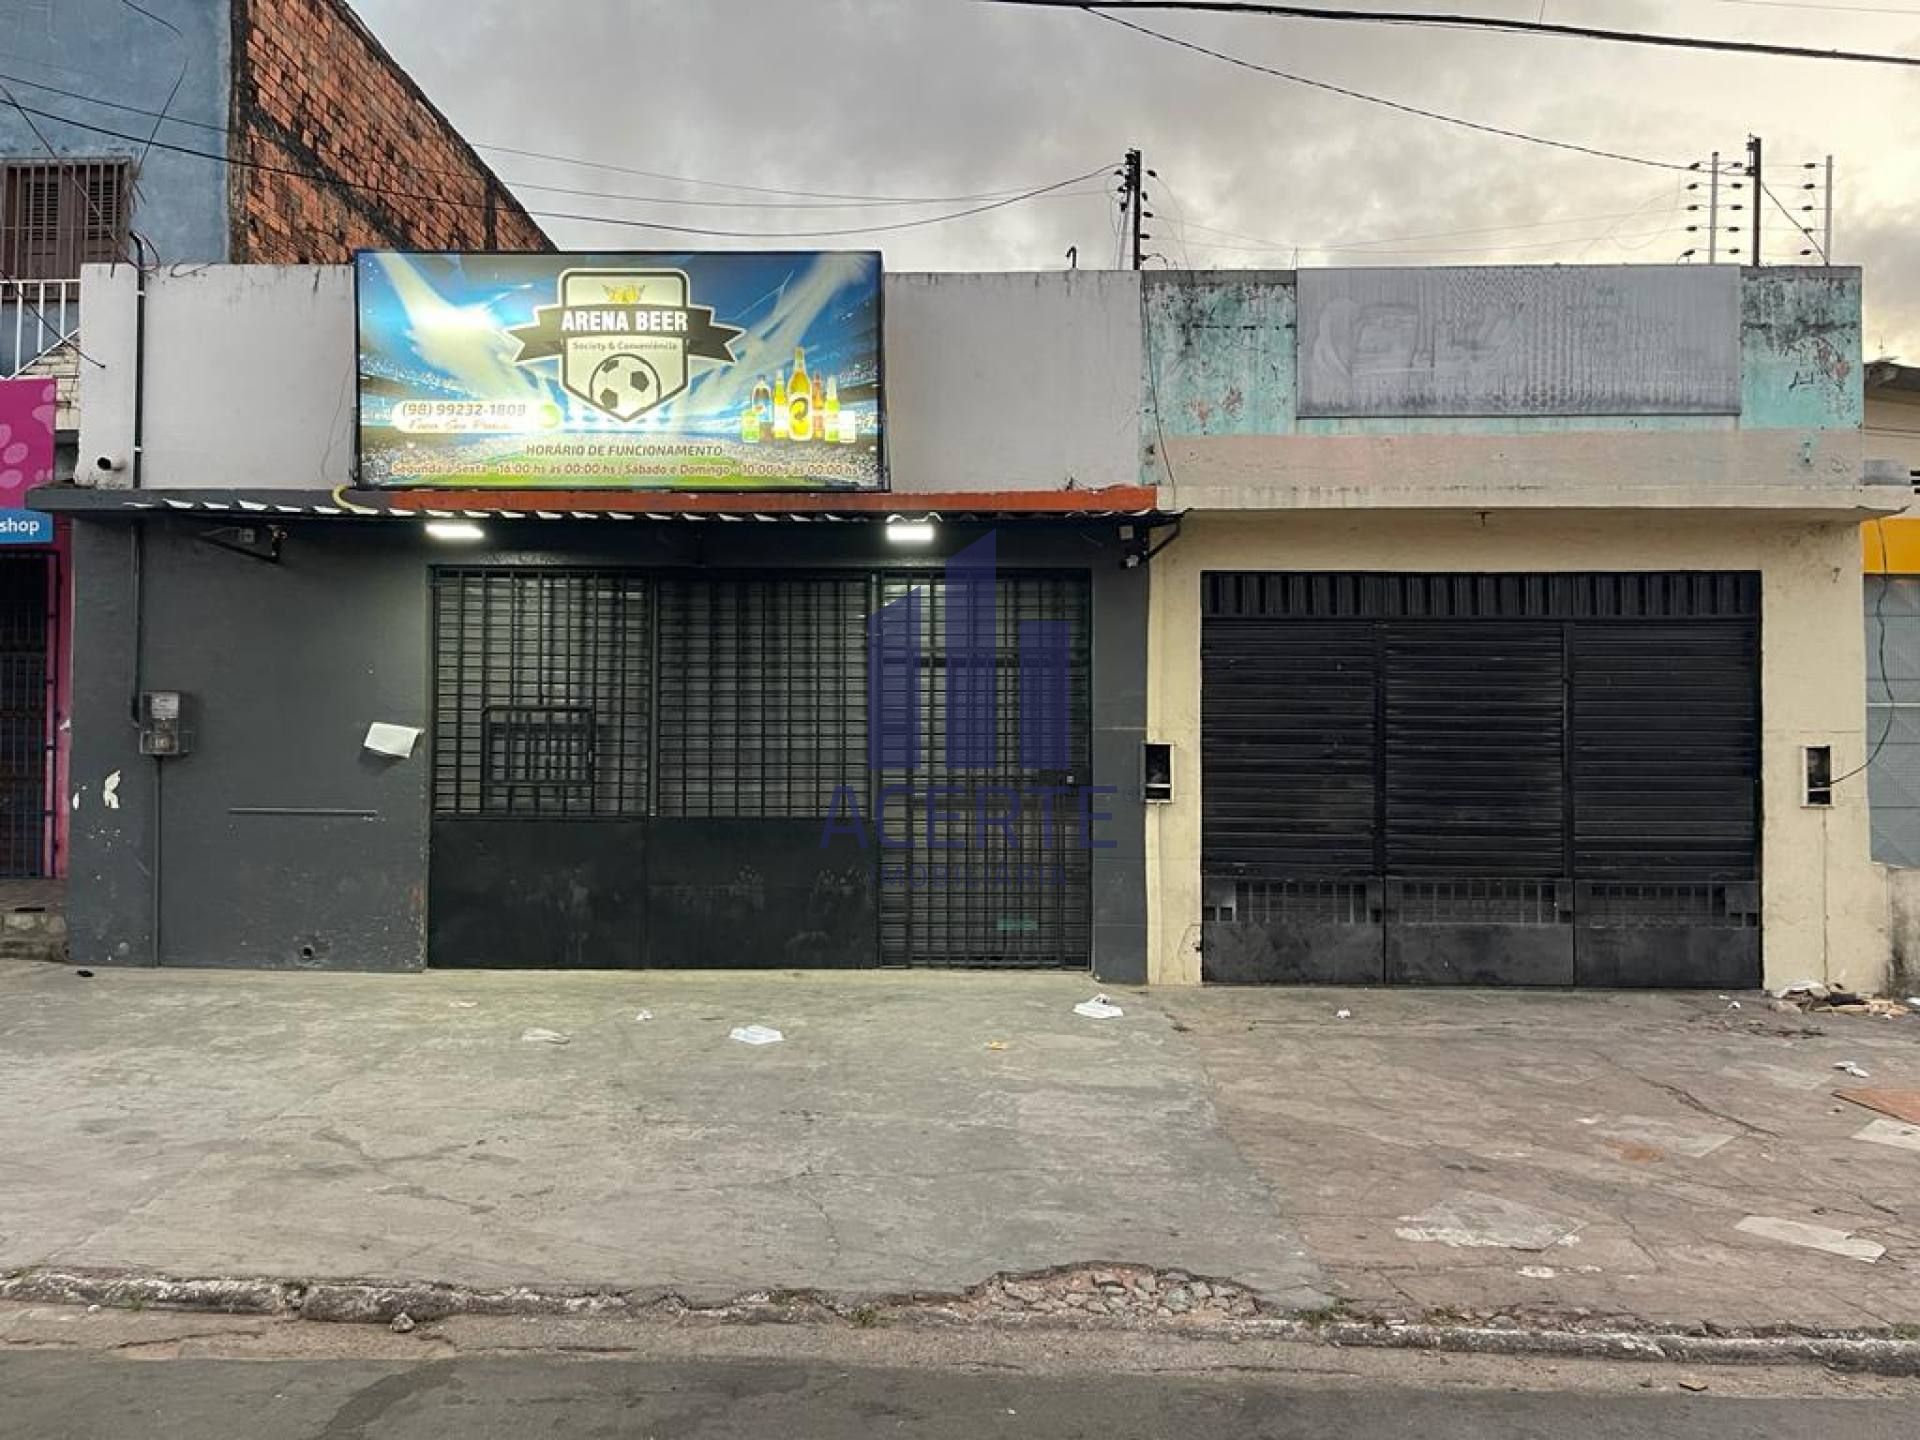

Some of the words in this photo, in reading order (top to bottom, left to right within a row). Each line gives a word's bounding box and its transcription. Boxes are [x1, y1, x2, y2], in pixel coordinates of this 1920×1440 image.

[561, 310, 629, 331] ARENA
[635, 310, 688, 331] BEER
[572, 341, 606, 351] Society
[402, 403, 432, 416] (98)
[527, 443, 584, 456] HORÁRIO
[588, 445, 604, 456] DE
[608, 444, 722, 457] FUNCIONAMENTO
[564, 464, 599, 474] 00:00
[603, 464, 615, 473] hs
[625, 463, 666, 475] Sábado
[680, 464, 730, 477] Domingo
[807, 464, 841, 475] 00:00
[0, 517, 40, 536] shop
